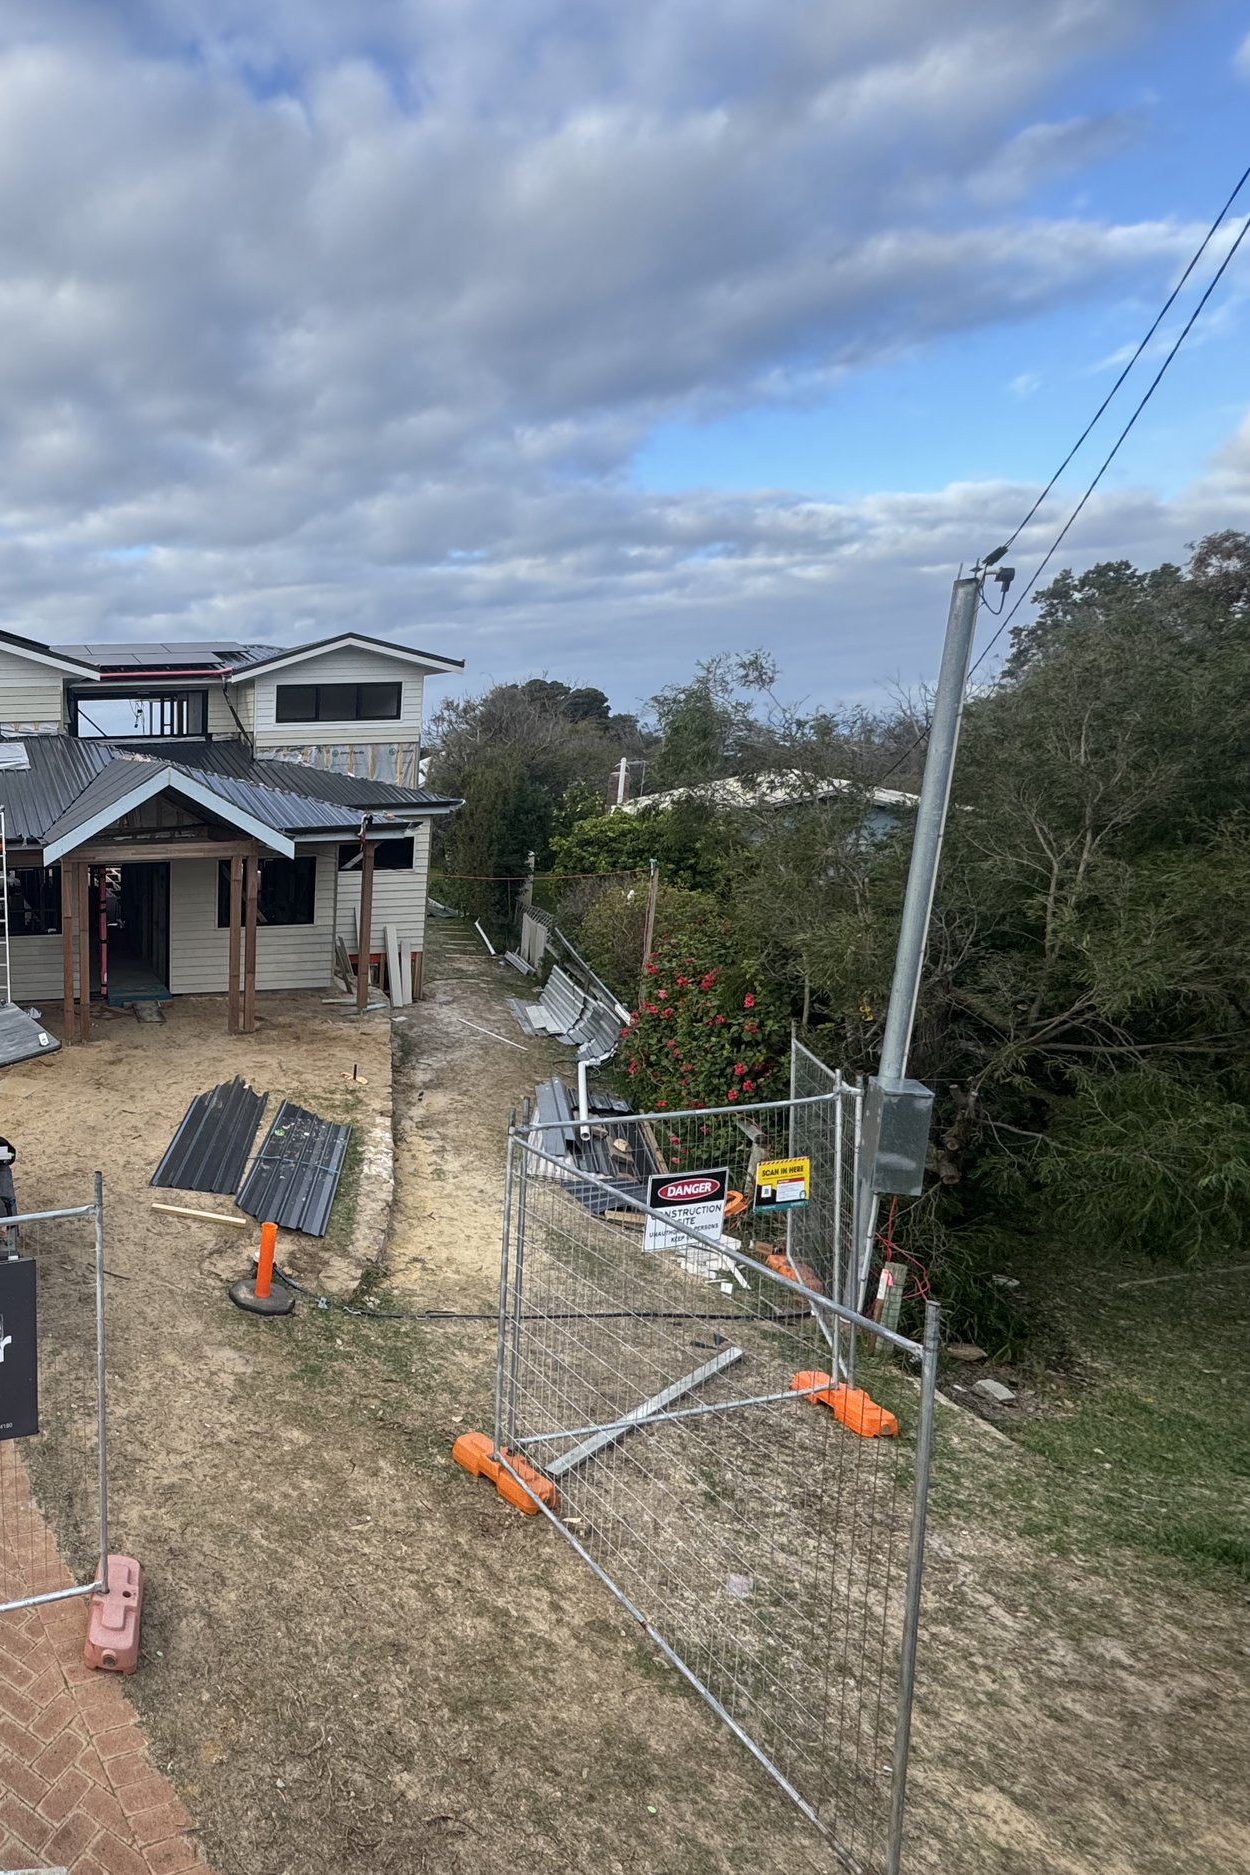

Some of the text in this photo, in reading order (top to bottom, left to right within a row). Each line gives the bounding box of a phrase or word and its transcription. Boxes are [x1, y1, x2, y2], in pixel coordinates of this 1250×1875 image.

[789, 1165, 804, 1173] HERE
[667, 1182, 712, 1197] DANGER
[652, 1204, 722, 1220] NSTRUCTION
[694, 1223, 719, 1231] PERSONS
